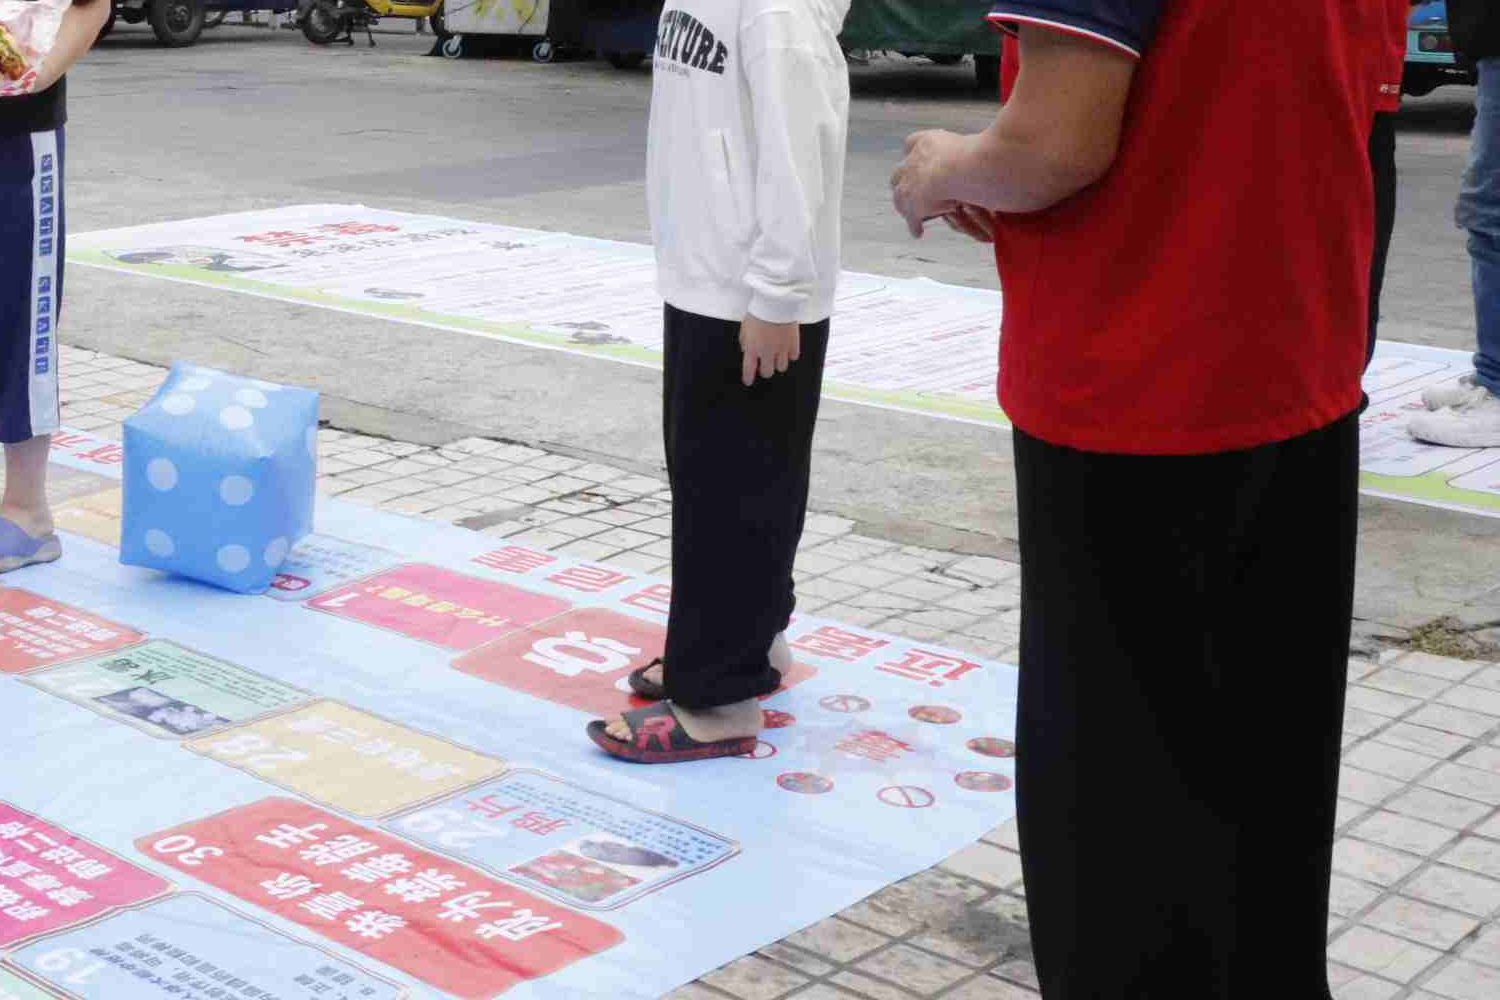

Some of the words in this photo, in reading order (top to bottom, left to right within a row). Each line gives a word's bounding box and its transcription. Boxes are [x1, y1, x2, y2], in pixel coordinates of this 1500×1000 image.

[402, 806, 502, 850] 29
[467, 792, 575, 838] 鸦片
[150, 831, 227, 869] 30
[250, 821, 566, 946] 成为禁毒能手
[256, 869, 410, 942] 恭喜你
[23, 942, 125, 989] 19
